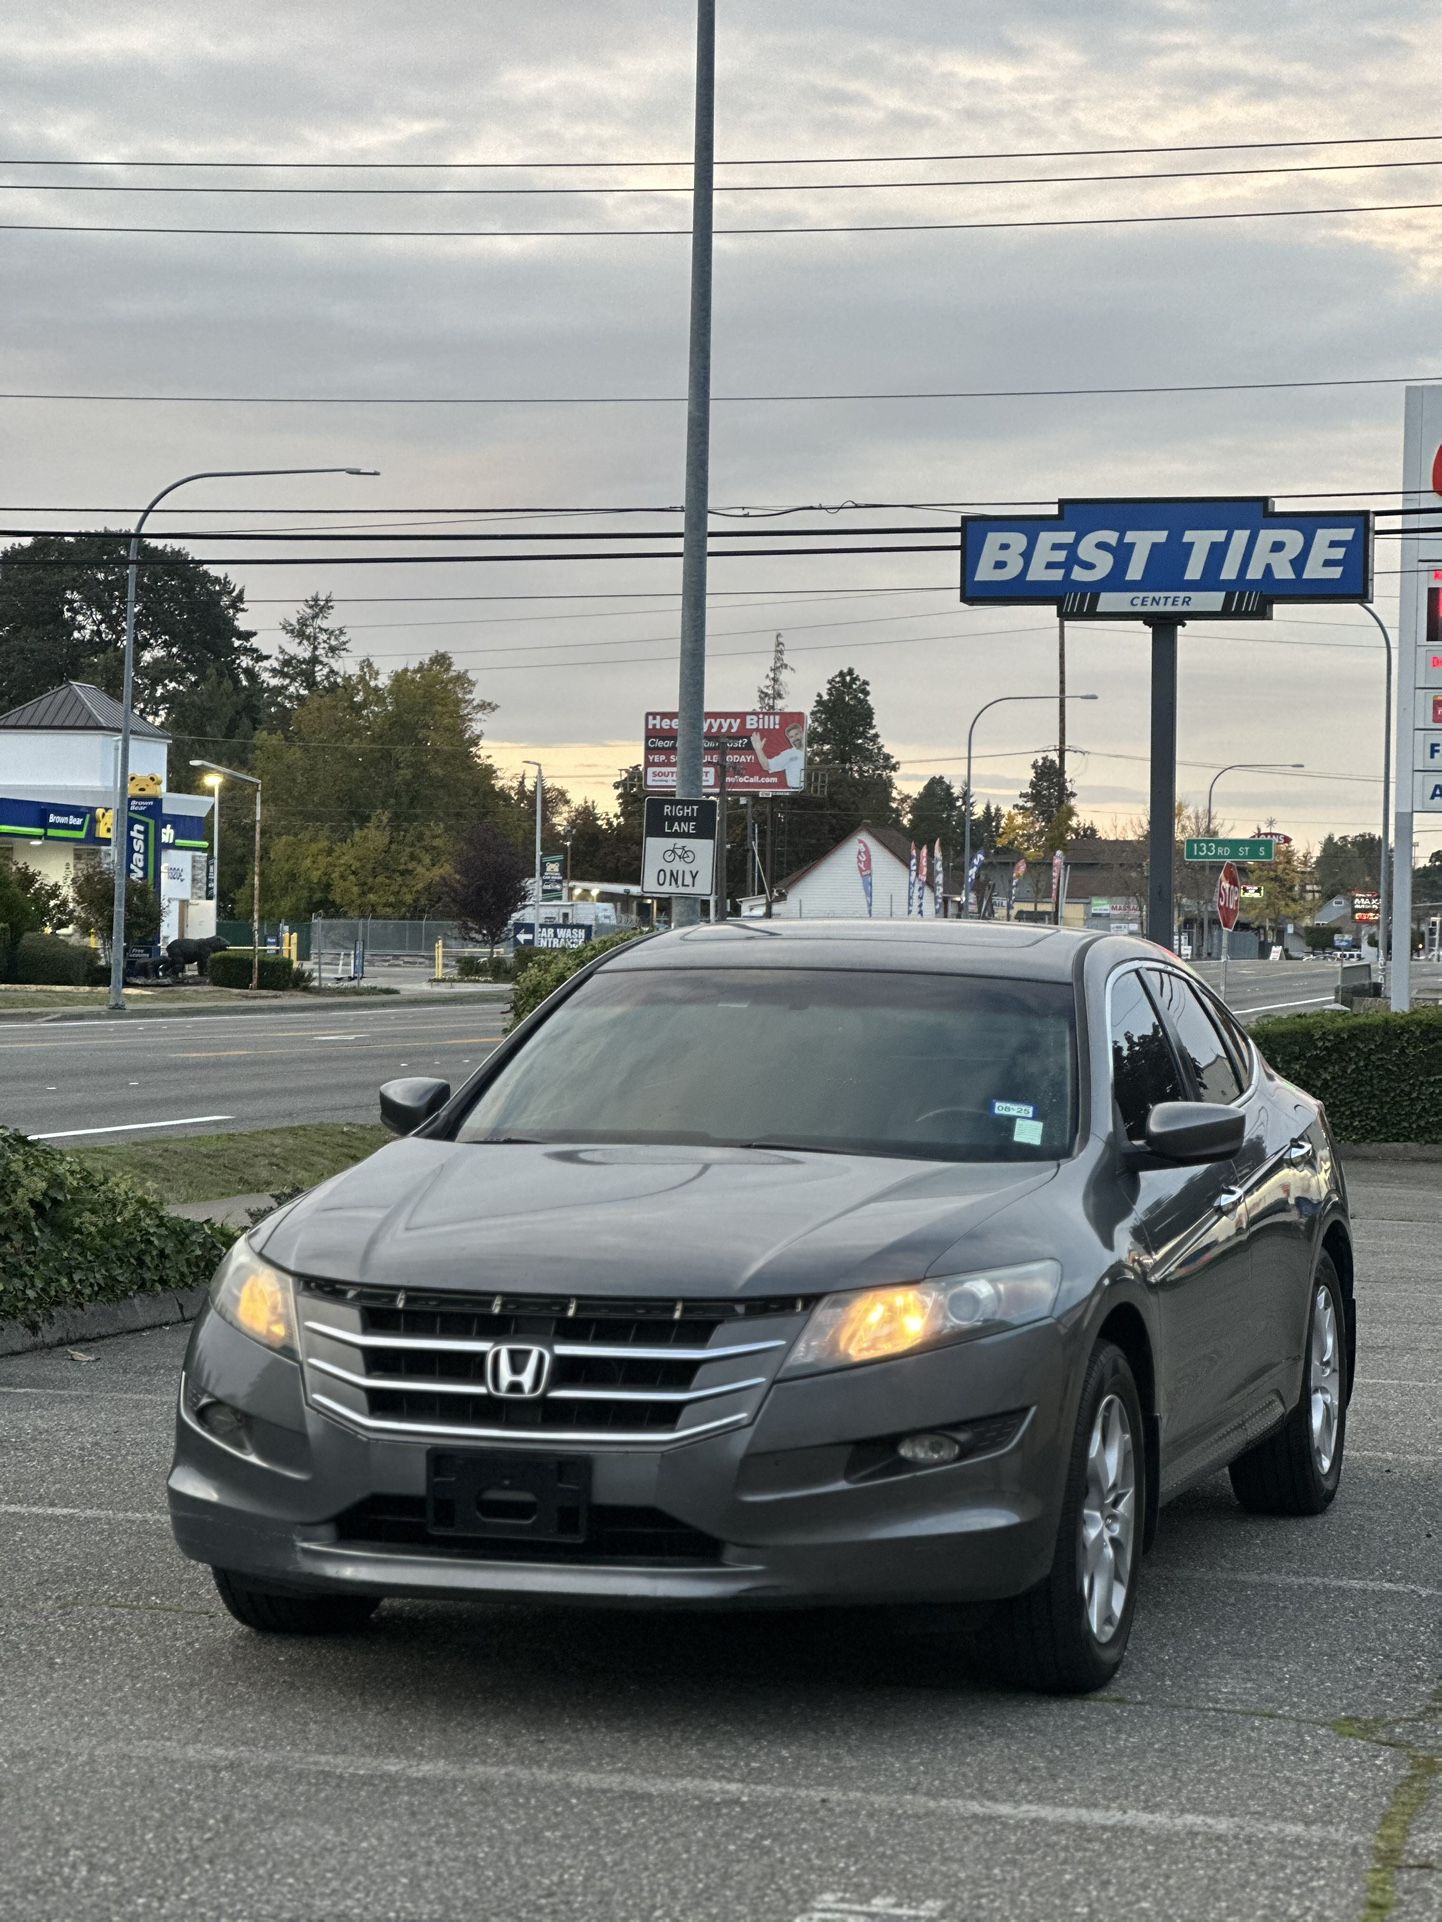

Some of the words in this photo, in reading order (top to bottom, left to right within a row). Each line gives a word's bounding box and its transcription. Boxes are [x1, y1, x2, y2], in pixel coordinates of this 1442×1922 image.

[974, 530, 1169, 582] BEST
[1183, 528, 1355, 581] TIRE
[1130, 596, 1192, 607] CENTER
[745, 714, 780, 729] Bill!
[648, 739, 674, 748] Clear
[648, 754, 666, 763] YEP.
[726, 754, 755, 763] ODAY!
[664, 804, 699, 817] RIGHT
[49, 813, 68, 824] Brown
[69, 815, 84, 825] Bear
[664, 820, 697, 833] LANE
[1238, 847, 1250, 856] ST
[1259, 847, 1265, 856] S
[657, 868, 699, 887] ONLY
[1219, 881, 1239, 910] STOP
[556, 928, 585, 939] WASH
